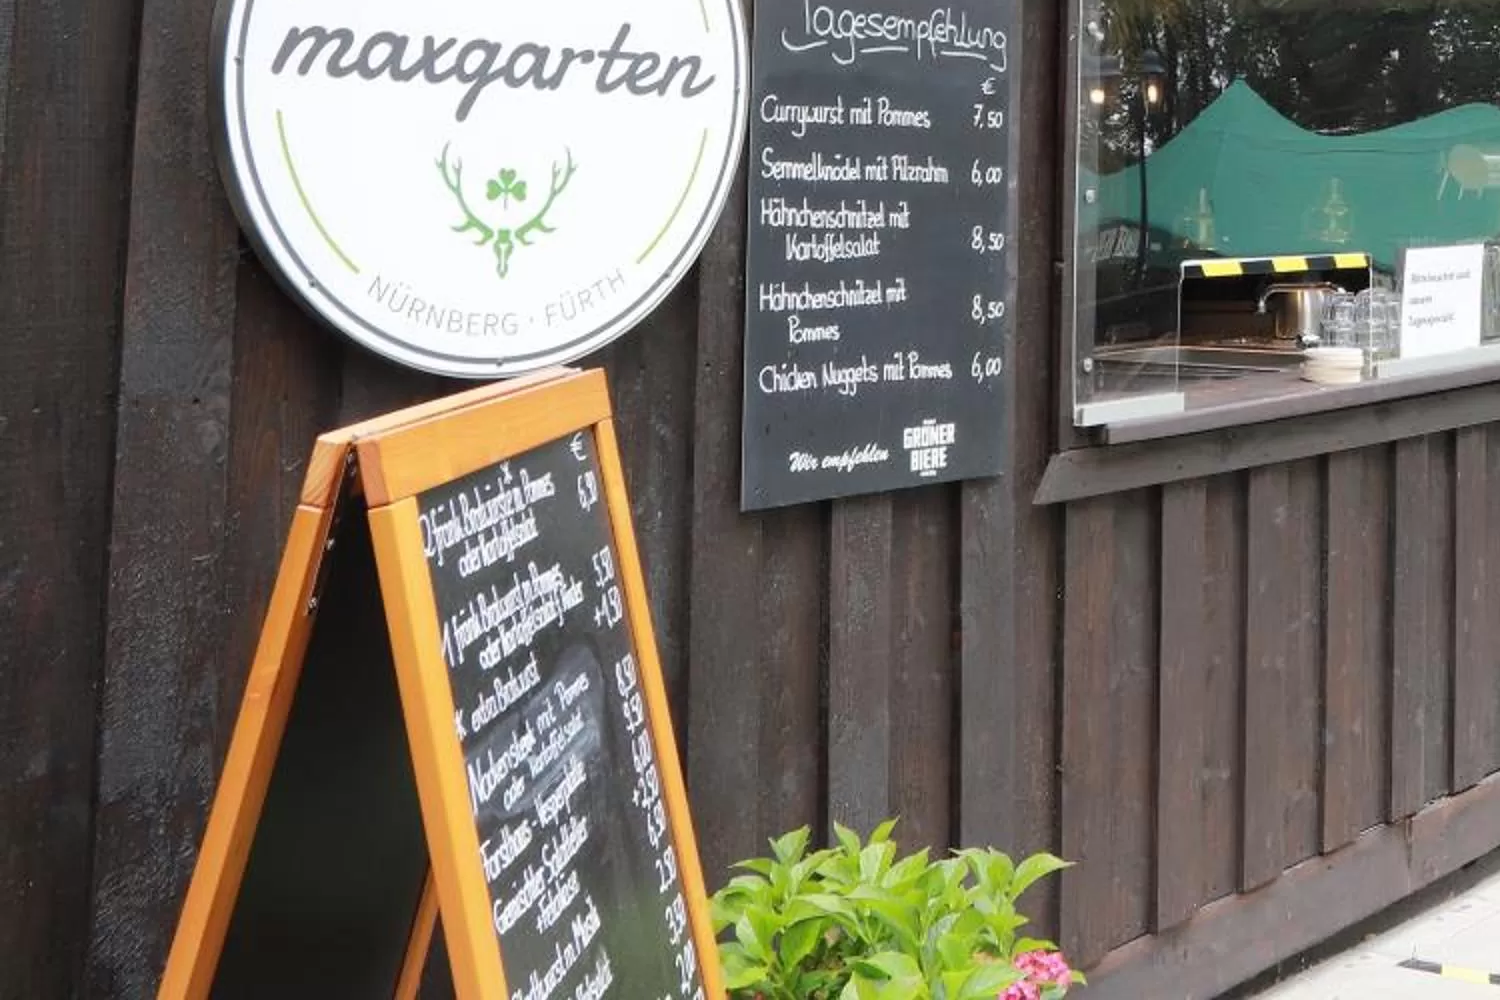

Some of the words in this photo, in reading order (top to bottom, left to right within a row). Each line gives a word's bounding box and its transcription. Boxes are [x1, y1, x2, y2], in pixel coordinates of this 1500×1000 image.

[271, 23, 717, 123] maxgarten
[980, 77, 997, 95] €
[760, 94, 845, 138] Currywurst
[850, 96, 872, 126] mit
[877, 95, 932, 130] Pommes
[761, 147, 862, 182] Semmelknödel
[865, 155, 888, 182] mit
[971, 158, 1003, 188] 6,00
[760, 196, 886, 229] Hähnchenschnitzel
[889, 200, 911, 229] mit
[785, 231, 881, 264] Kartoffelsalat
[971, 225, 1005, 255] 8,50
[366, 274, 520, 338] NÜRNBERG
[545, 272, 626, 328] FÜRTH
[759, 279, 883, 313] Hähnchenschnitzel
[886, 277, 907, 303] mit
[971, 293, 1005, 325] 8,50
[787, 314, 841, 344] Pommes
[822, 354, 879, 397] Nuggets
[883, 351, 905, 382] mit
[907, 350, 954, 380] Pommes
[971, 351, 1002, 385] 6,00
[569, 431, 588, 462] €
[821, 441, 890, 473] empfehlen
[910, 446, 948, 473] BIERE
[519, 467, 556, 505] Pommes
[458, 539, 482, 579] oder
[477, 506, 540, 567] Kartoffelsalat
